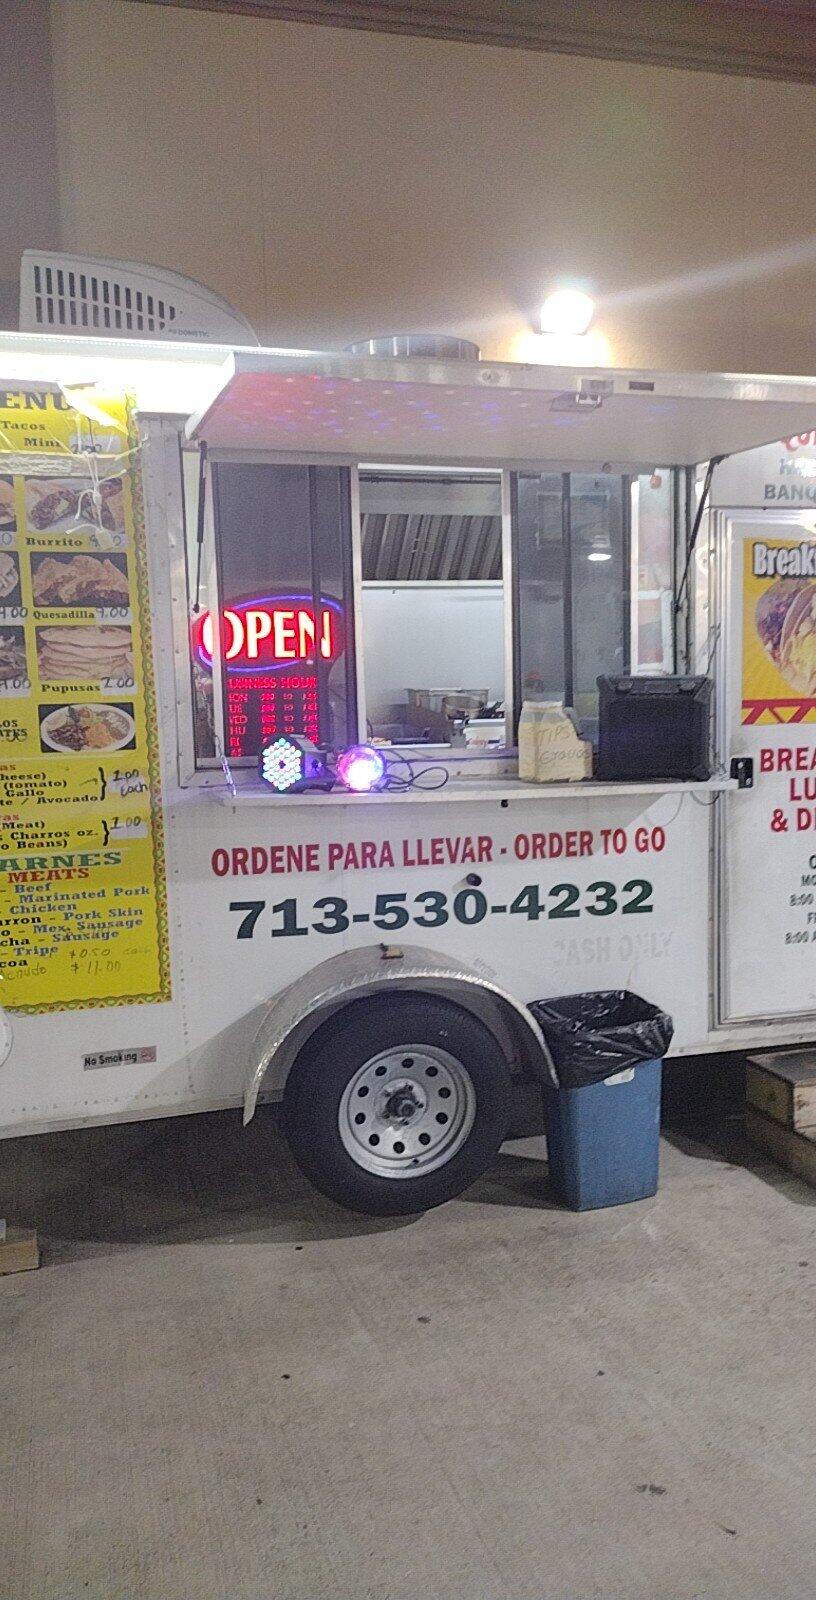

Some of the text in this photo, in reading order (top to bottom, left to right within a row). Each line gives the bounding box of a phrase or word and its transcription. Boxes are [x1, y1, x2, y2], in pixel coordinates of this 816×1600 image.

[1, 420, 46, 431] Tacos
[25, 537, 83, 547] Burrito
[752, 541, 816, 578] Break
[33, 610, 95, 620] Quesadilla
[202, 610, 331, 660] OPEN
[41, 684, 100, 693] Pupusas
[0, 720, 18, 728] OS
[4, 780, 67, 790] (tomato)
[5, 789, 45, 798] Gallo
[36, 795, 98, 805] Avocado
[770, 808, 788, 832] &
[10, 831, 70, 840] Charros
[17, 839, 68, 849] Beans)
[211, 843, 320, 877] ORDENE
[328, 840, 395, 871] PARA
[402, 835, 494, 867] LLEVAR
[514, 830, 594, 861] ORDER
[600, 827, 628, 855] TO
[634, 826, 666, 853] GO
[0, 852, 122, 871] ARNES
[8, 868, 90, 883] MEATS
[14, 883, 51, 893] Beef
[19, 890, 106, 903] Marinated
[113, 886, 150, 896] Pork
[9, 903, 77, 915] Chicken
[63, 911, 101, 921] Pork
[108, 907, 144, 918] Skin
[229, 879, 654, 939] 713-530-4232
[77, 919, 143, 931] Sausage
[52, 931, 119, 943] Sausage
[14, 946, 59, 957] Tripe
[84, 1057, 97, 1067] No
